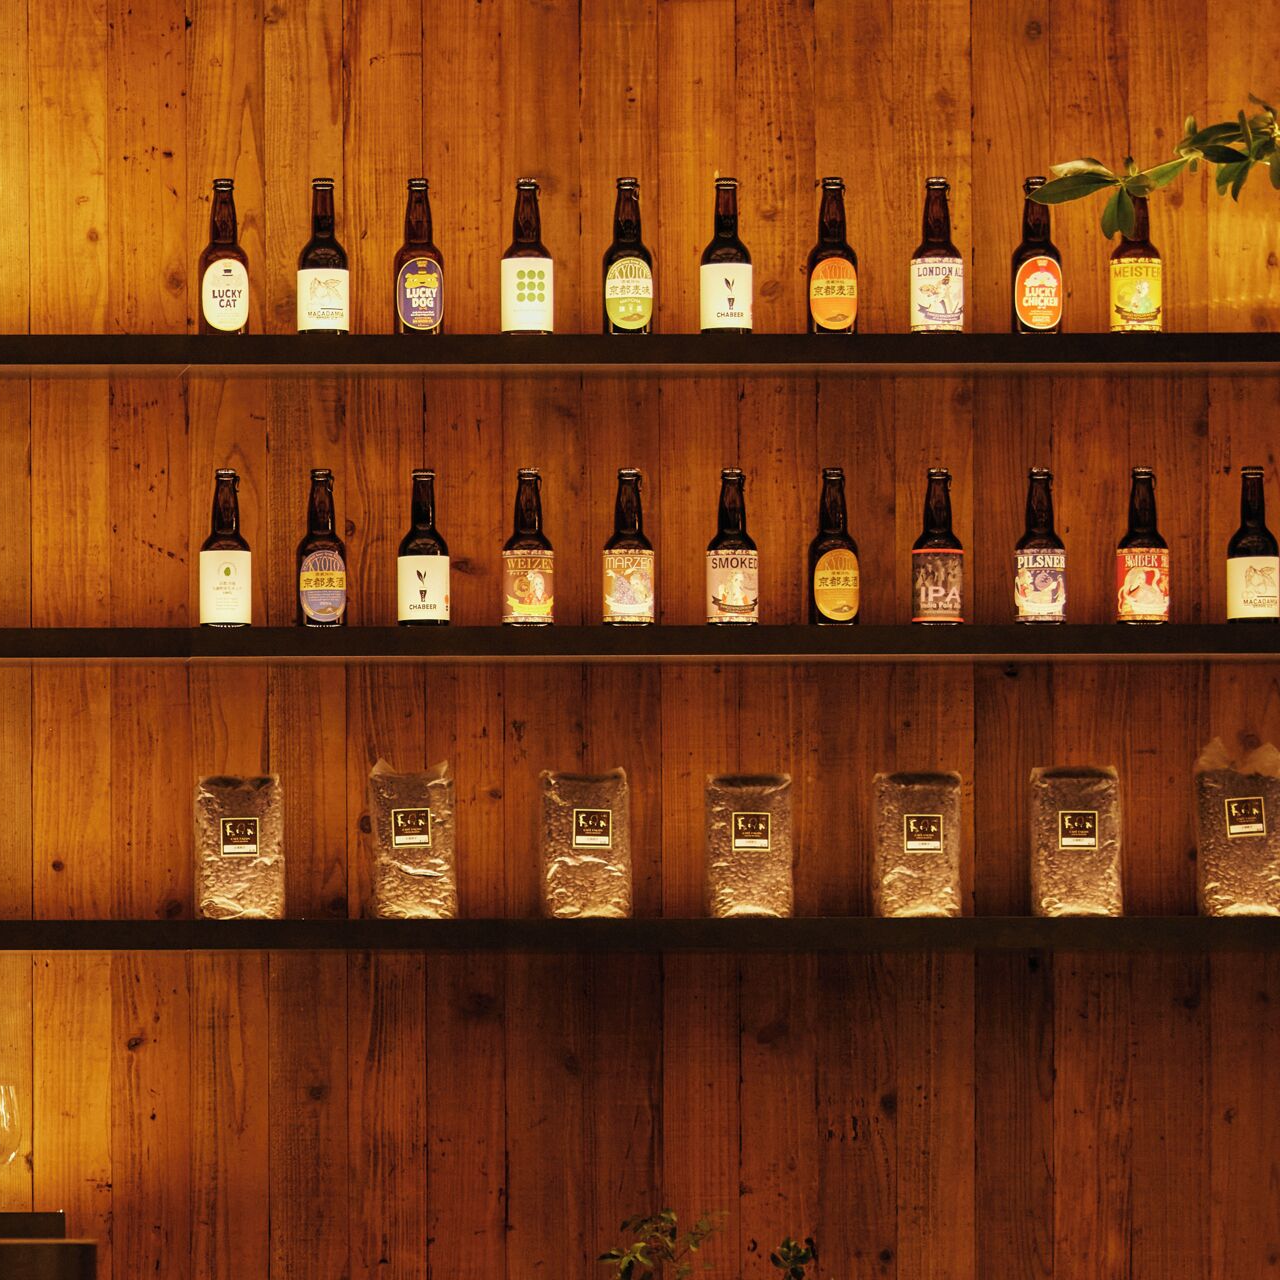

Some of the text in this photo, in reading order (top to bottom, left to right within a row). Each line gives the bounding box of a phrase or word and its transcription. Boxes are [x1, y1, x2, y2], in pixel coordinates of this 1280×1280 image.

[614, 264, 646, 280] KYOTO
[917, 266, 952, 277] LONDON
[1113, 266, 1162, 277] MEISTER
[212, 288, 242, 299] LUCKY
[406, 288, 438, 298] LUCKY
[1025, 287, 1056, 297] LUCKY
[218, 299, 237, 308] CAT
[412, 298, 434, 308] DOG
[1022, 297, 1058, 308] CHICKEN
[507, 557, 553, 570] WEIZEN
[711, 557, 758, 569] SMOKED
[1017, 555, 1065, 568] PILSNER
[920, 586, 961, 602] IPA
[939, 602, 952, 610] Pale
